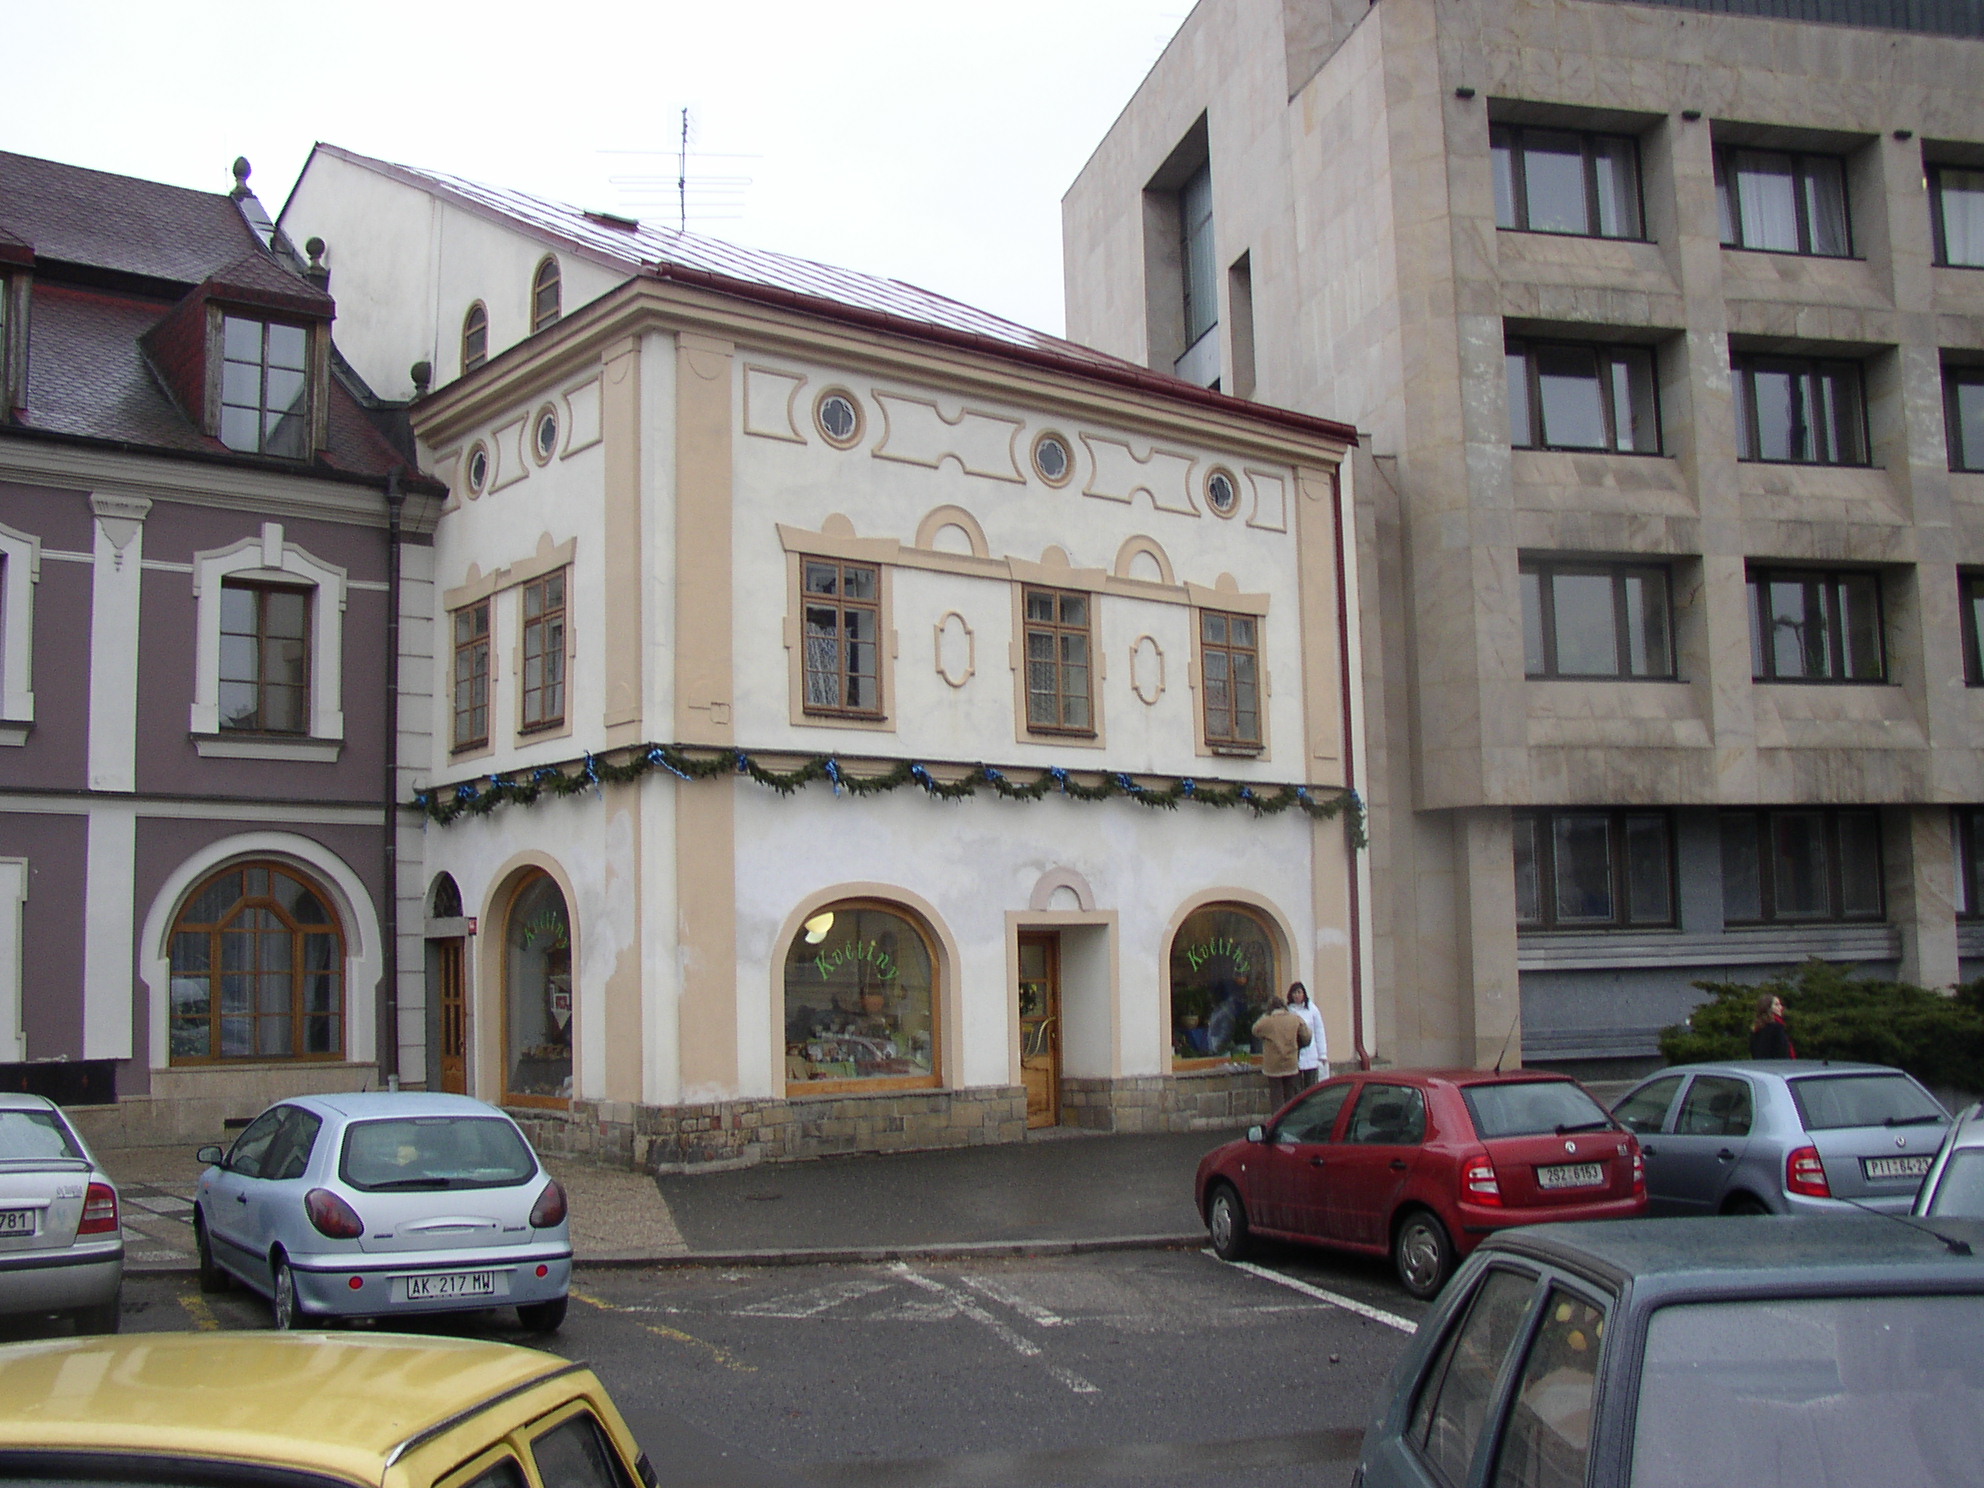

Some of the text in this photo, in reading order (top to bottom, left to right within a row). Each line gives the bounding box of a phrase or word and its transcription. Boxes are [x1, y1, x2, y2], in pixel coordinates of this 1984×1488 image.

[0, 1213, 26, 1229] 781
[412, 1273, 490, 1295] AK 217 MW
